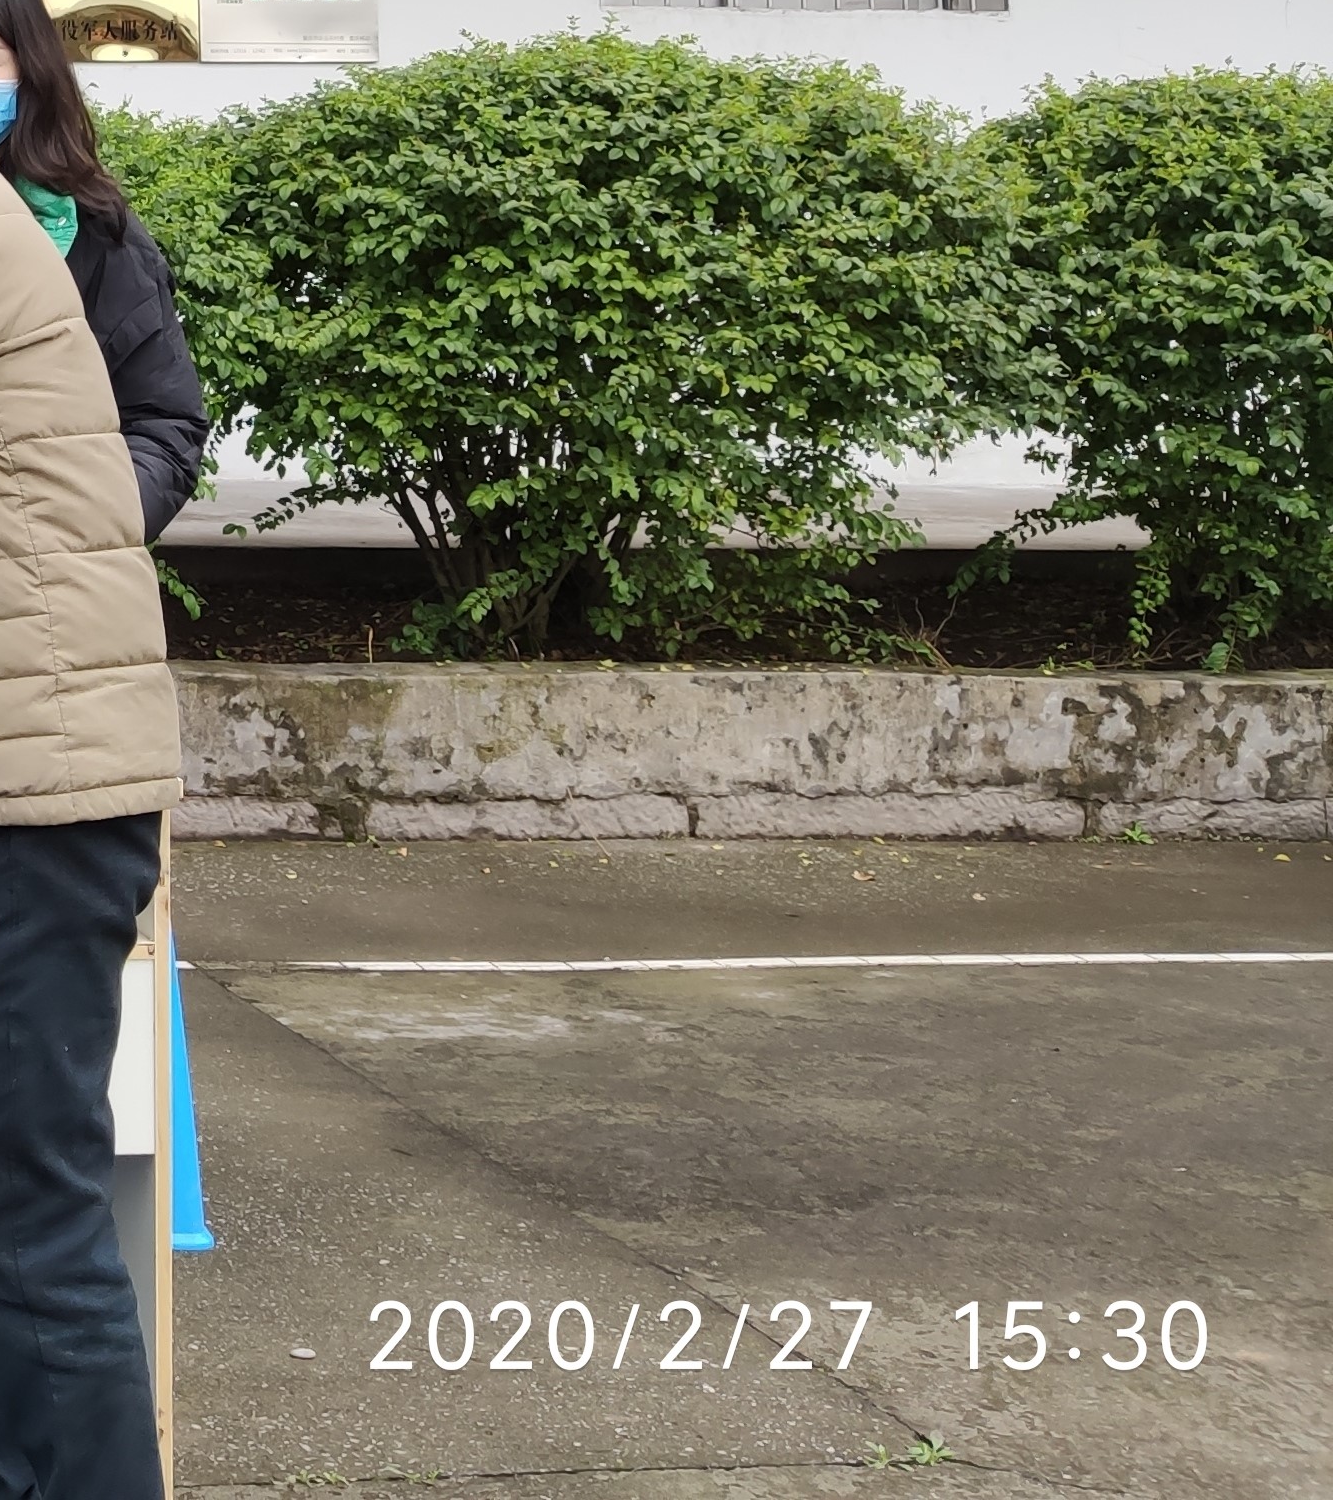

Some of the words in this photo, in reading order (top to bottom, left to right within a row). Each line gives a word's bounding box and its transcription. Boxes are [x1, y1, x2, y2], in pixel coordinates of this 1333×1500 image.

[53, 19, 179, 42] 役军人服务站
